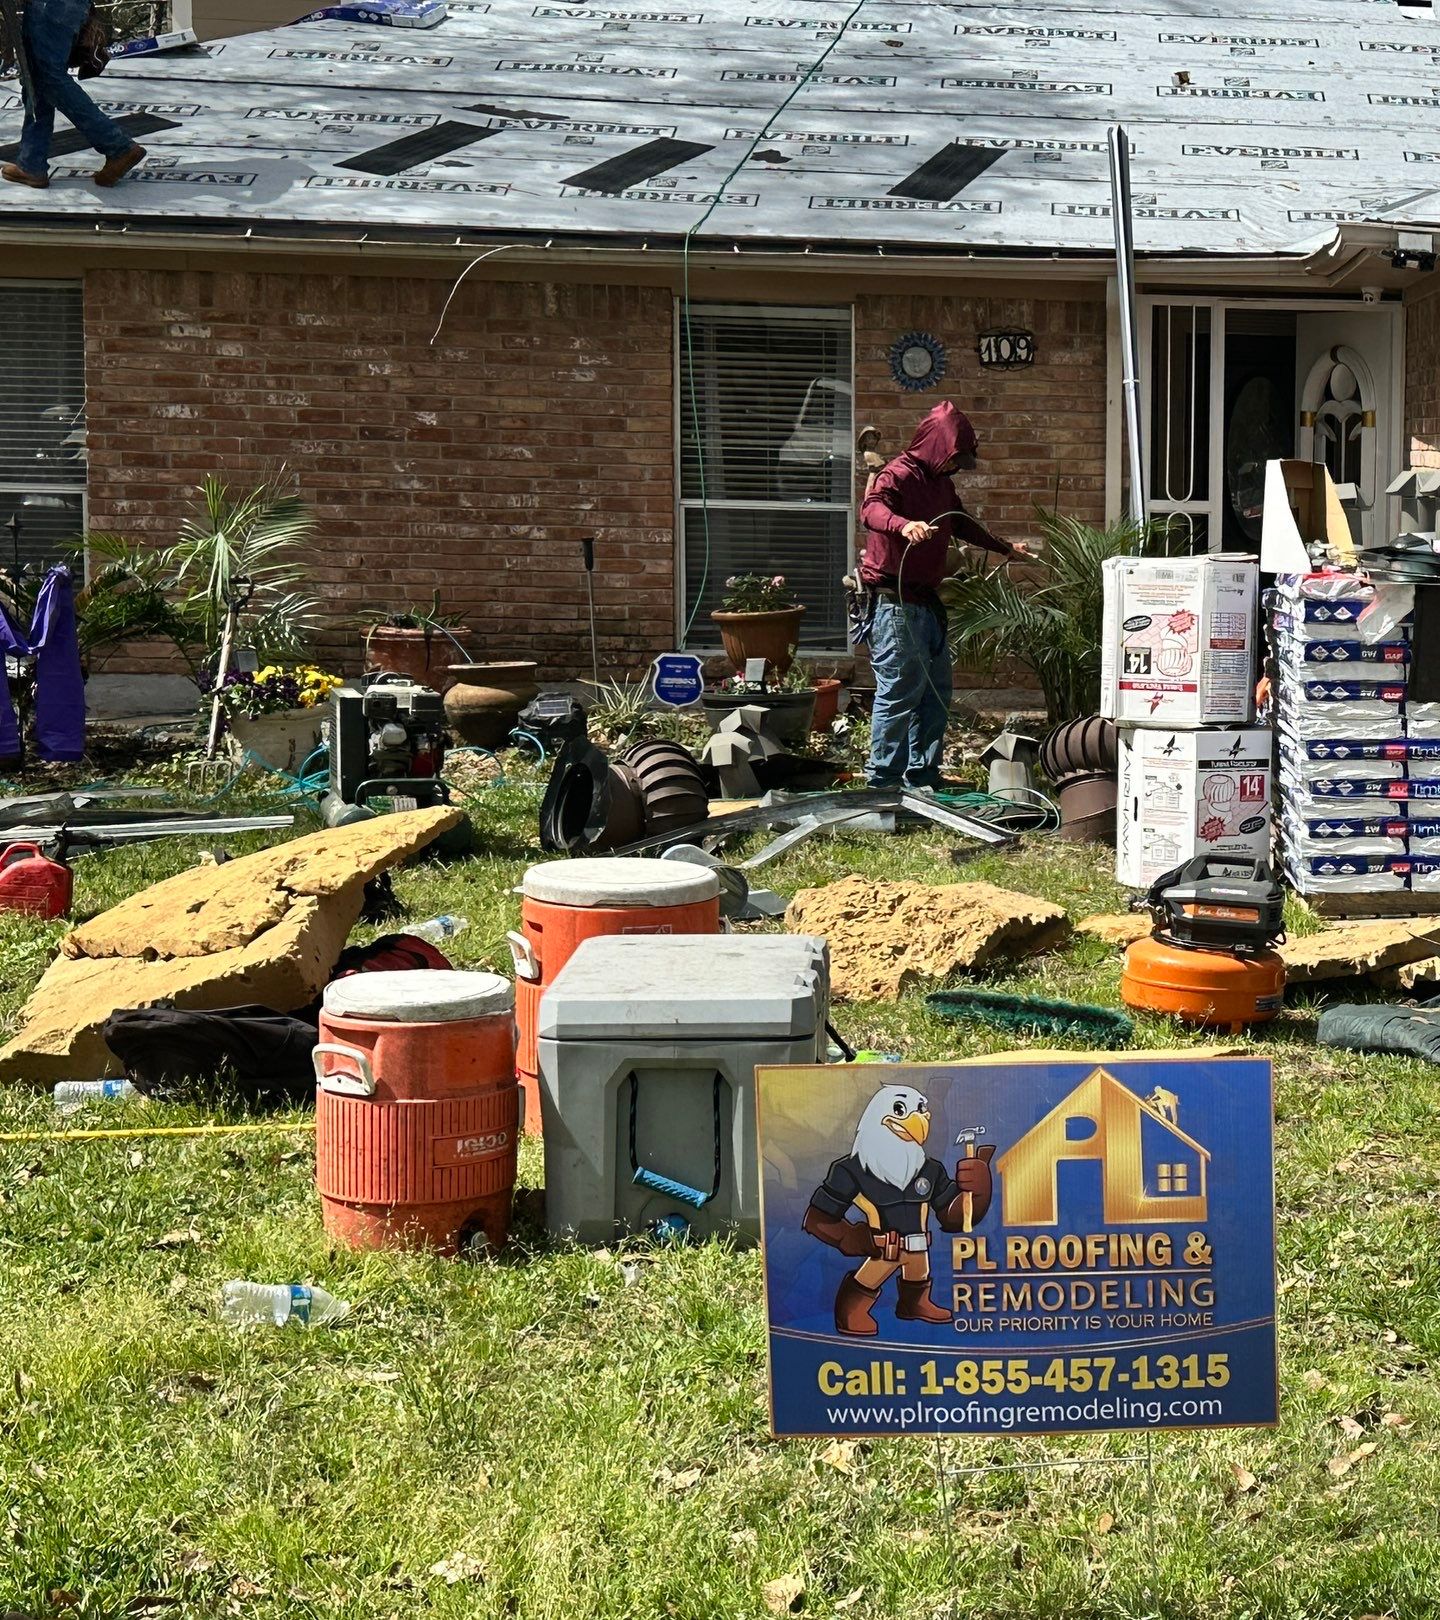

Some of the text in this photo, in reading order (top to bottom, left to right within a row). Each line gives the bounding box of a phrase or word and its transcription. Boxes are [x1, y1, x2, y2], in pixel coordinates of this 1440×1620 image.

[257, 109, 431, 124] EVERBILT
[498, 119, 667, 135] EVERBILT
[734, 130, 900, 143] EVERBILT
[966, 138, 1108, 152] EVERBIL
[1191, 146, 1350, 158] EVERBILT
[316, 178, 502, 193] EVERBILT
[818, 199, 992, 211] EVERBILT
[1060, 205, 1231, 219] EVERILT
[981, 335, 1033, 362] 109
[952, 1231, 1213, 1270] PL ROOFING &
[953, 1277, 1215, 1314] REMODELING
[954, 1311, 1214, 1332] OUR PRIORITY IS YOUR HOME
[818, 1353, 1230, 1397] Call: 1-855-457-1315
[826, 1397, 1223, 1429] www.plroofingremodeling.com
